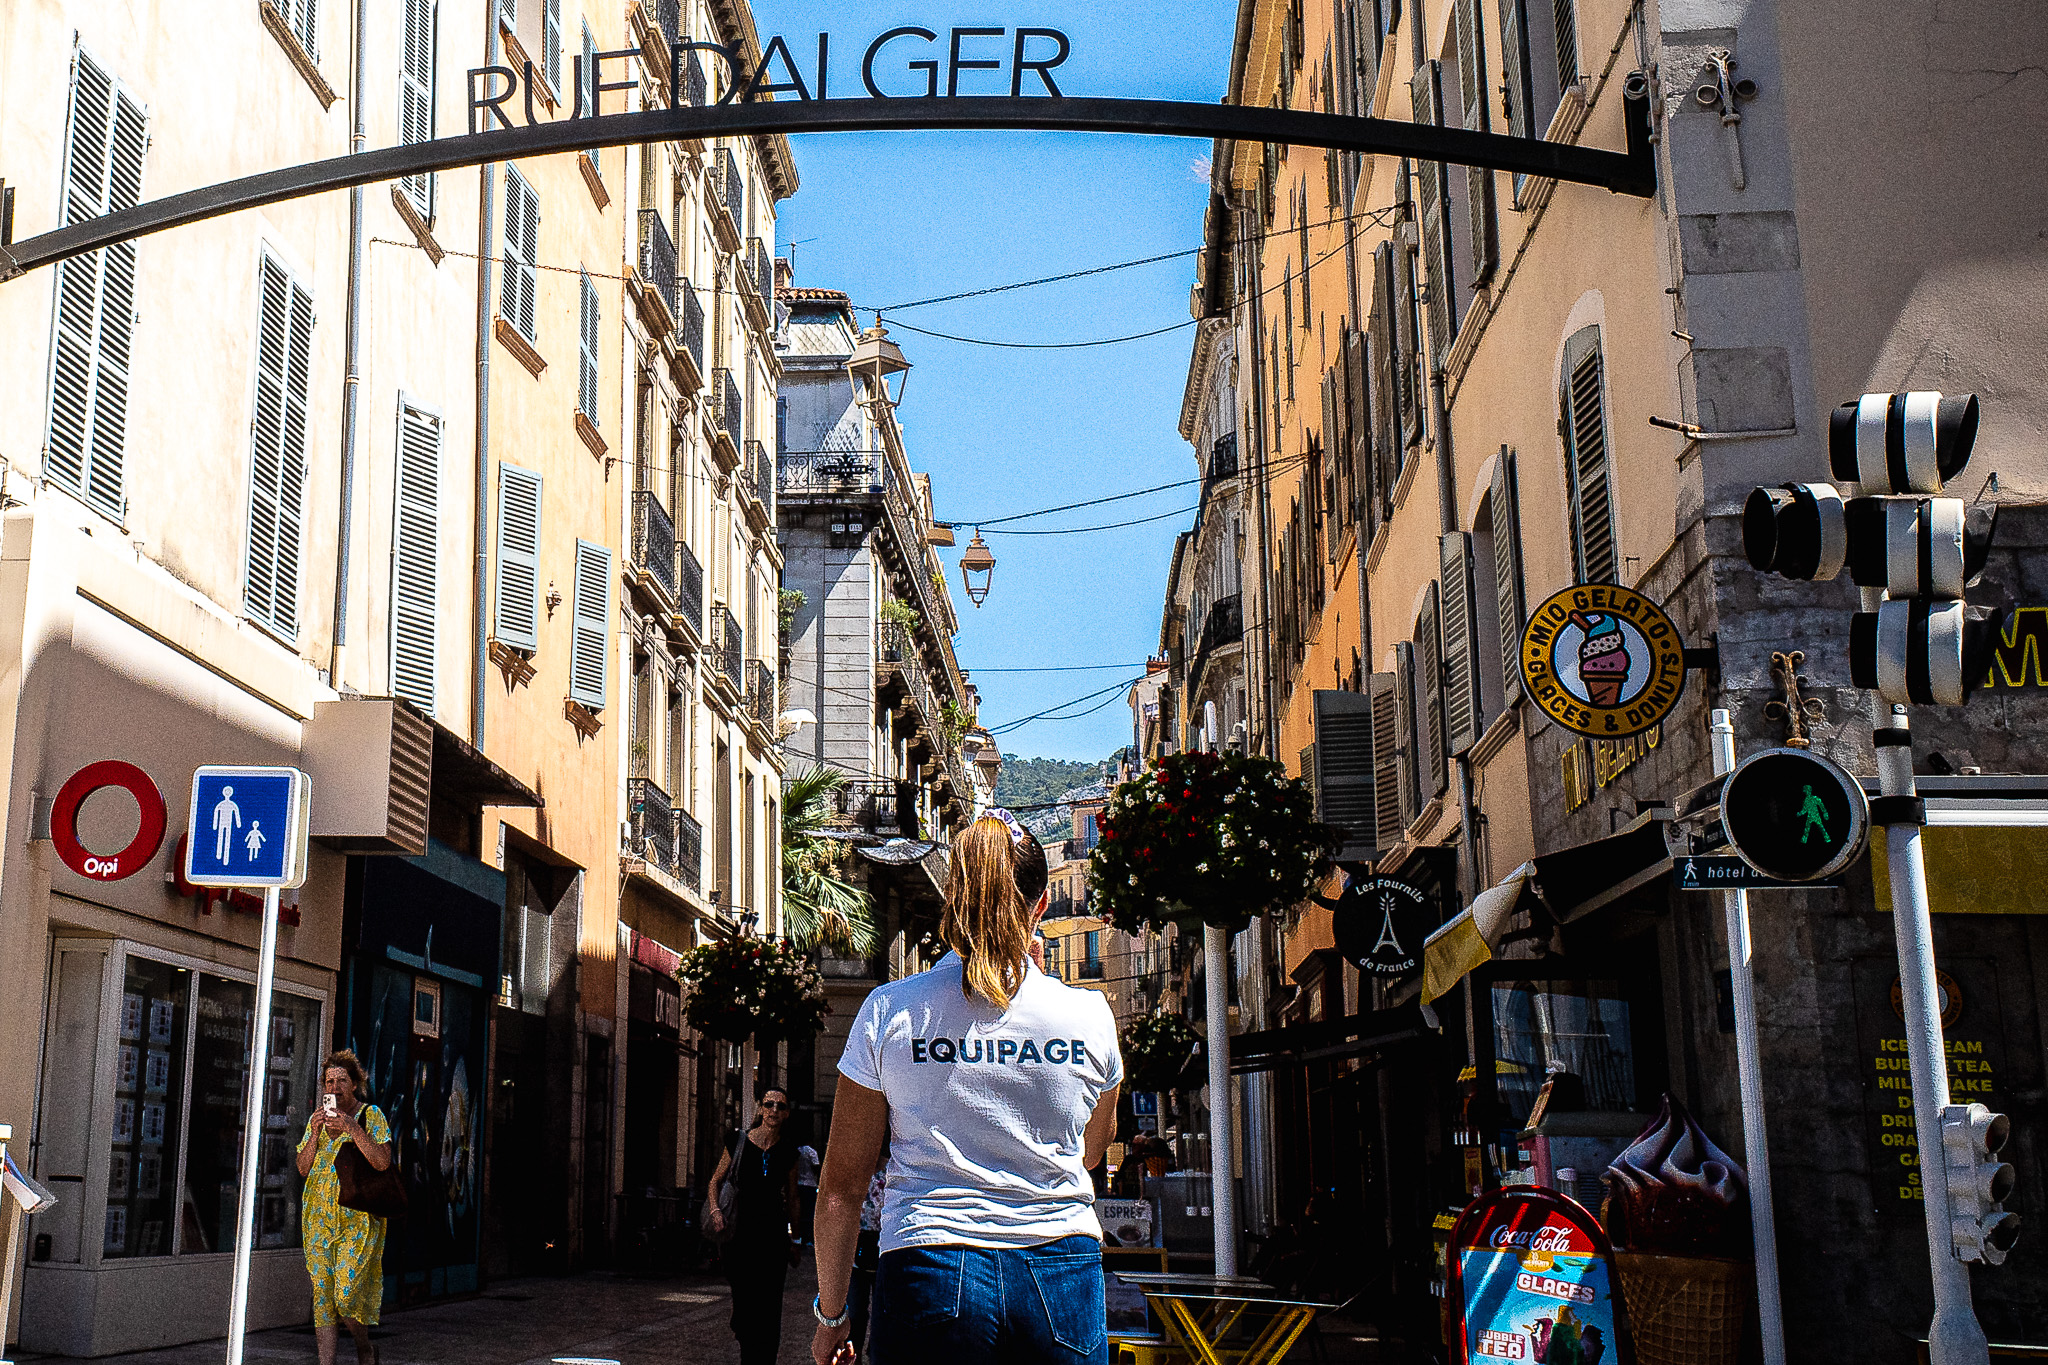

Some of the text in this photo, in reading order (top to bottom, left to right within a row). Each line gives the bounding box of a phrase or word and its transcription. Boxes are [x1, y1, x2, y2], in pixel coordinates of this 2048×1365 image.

[466, 47, 643, 133] RUE
[1528, 588, 1669, 647] MIO GELATO
[1527, 652, 1680, 732] GLACES & DONUTS
[83, 857, 119, 877] Orpi
[1707, 866, 1745, 878] hôtel
[1355, 878, 1425, 903] Les Fournils
[1359, 957, 1415, 972] de France
[911, 1037, 1085, 1065] EQUIPAGE
[1880, 1038, 1982, 1054] ICE EAM
[1953, 1059, 1993, 1073] TEA
[1879, 1076, 1993, 1092] MILAKE
[1489, 1224, 1573, 1252] Coca-Cola
[1518, 1274, 1594, 1301] GLACES
[1478, 1329, 1524, 1343] BUBBLE
[1481, 1339, 1522, 1358] TEA
